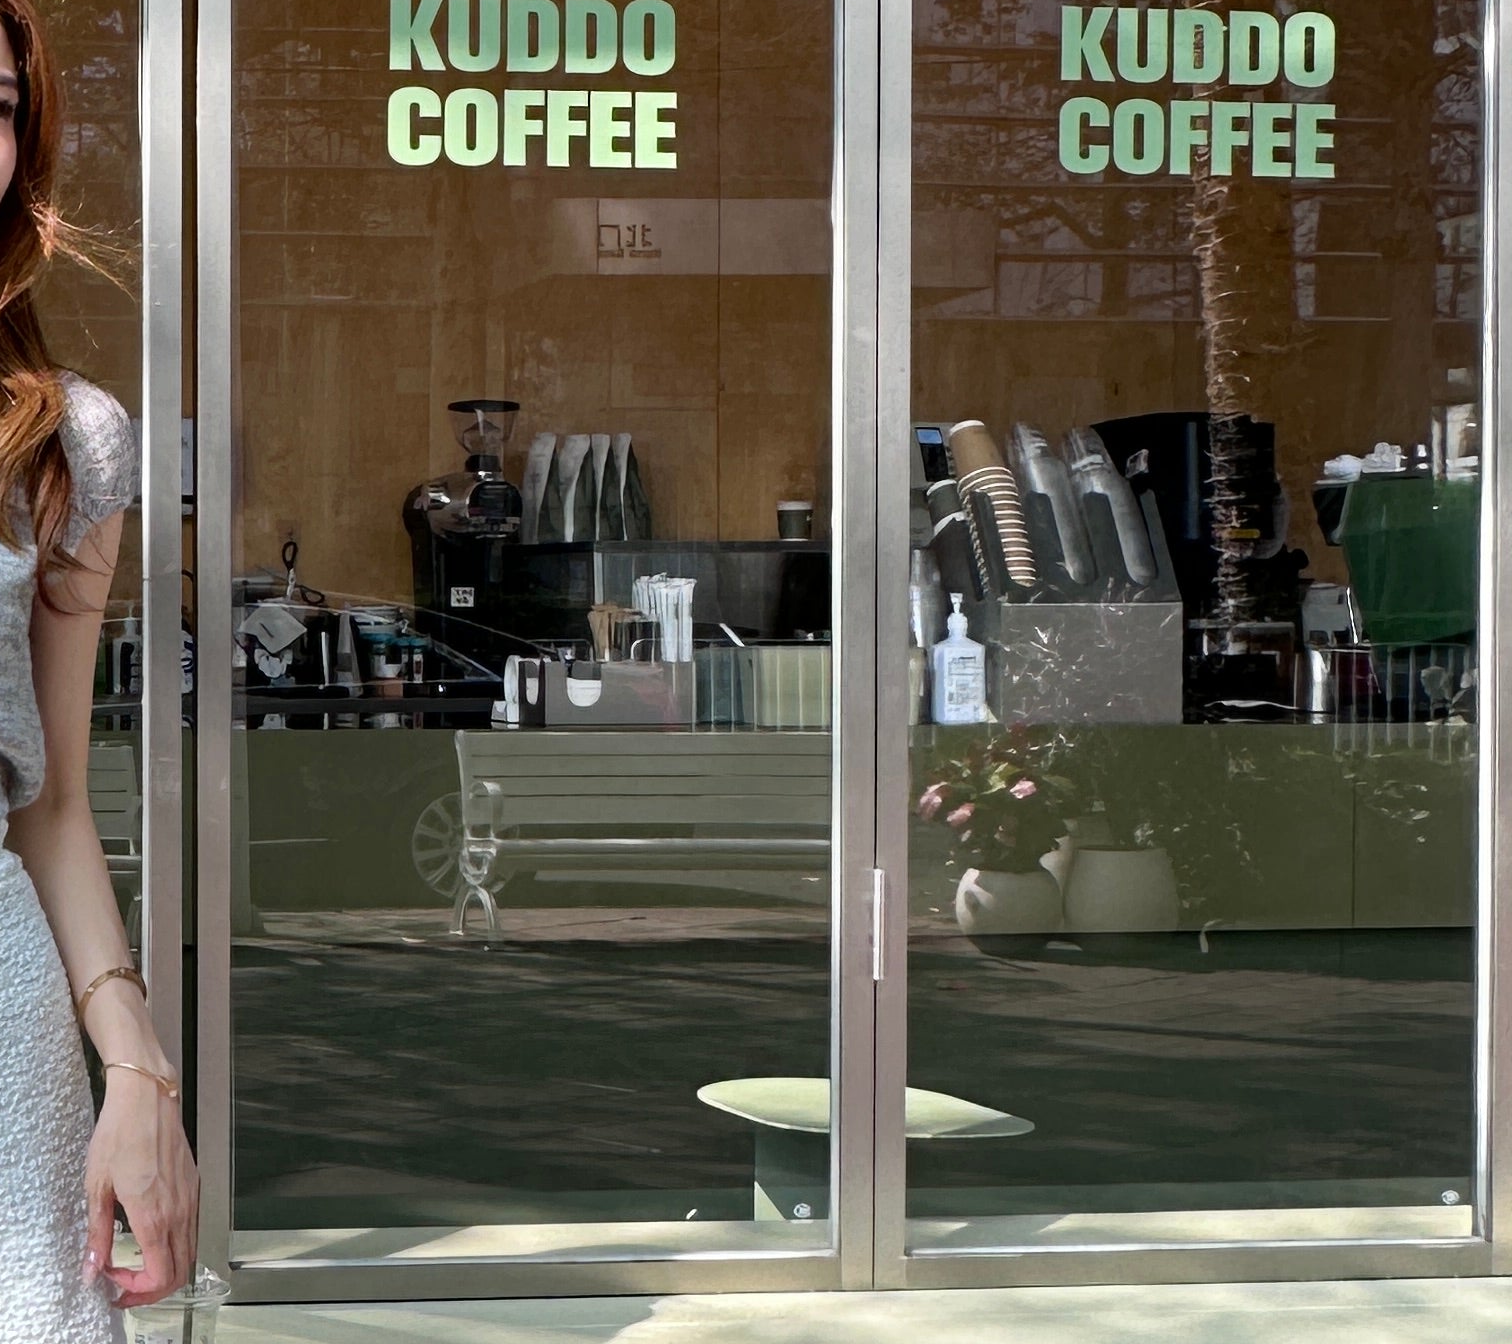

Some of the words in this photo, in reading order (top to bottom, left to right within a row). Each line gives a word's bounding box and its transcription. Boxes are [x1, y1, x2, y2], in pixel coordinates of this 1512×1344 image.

[1061, 5, 1336, 88] KUDDO
[387, 86, 678, 169] COFFEE
[1058, 96, 1336, 178] COFFEE
